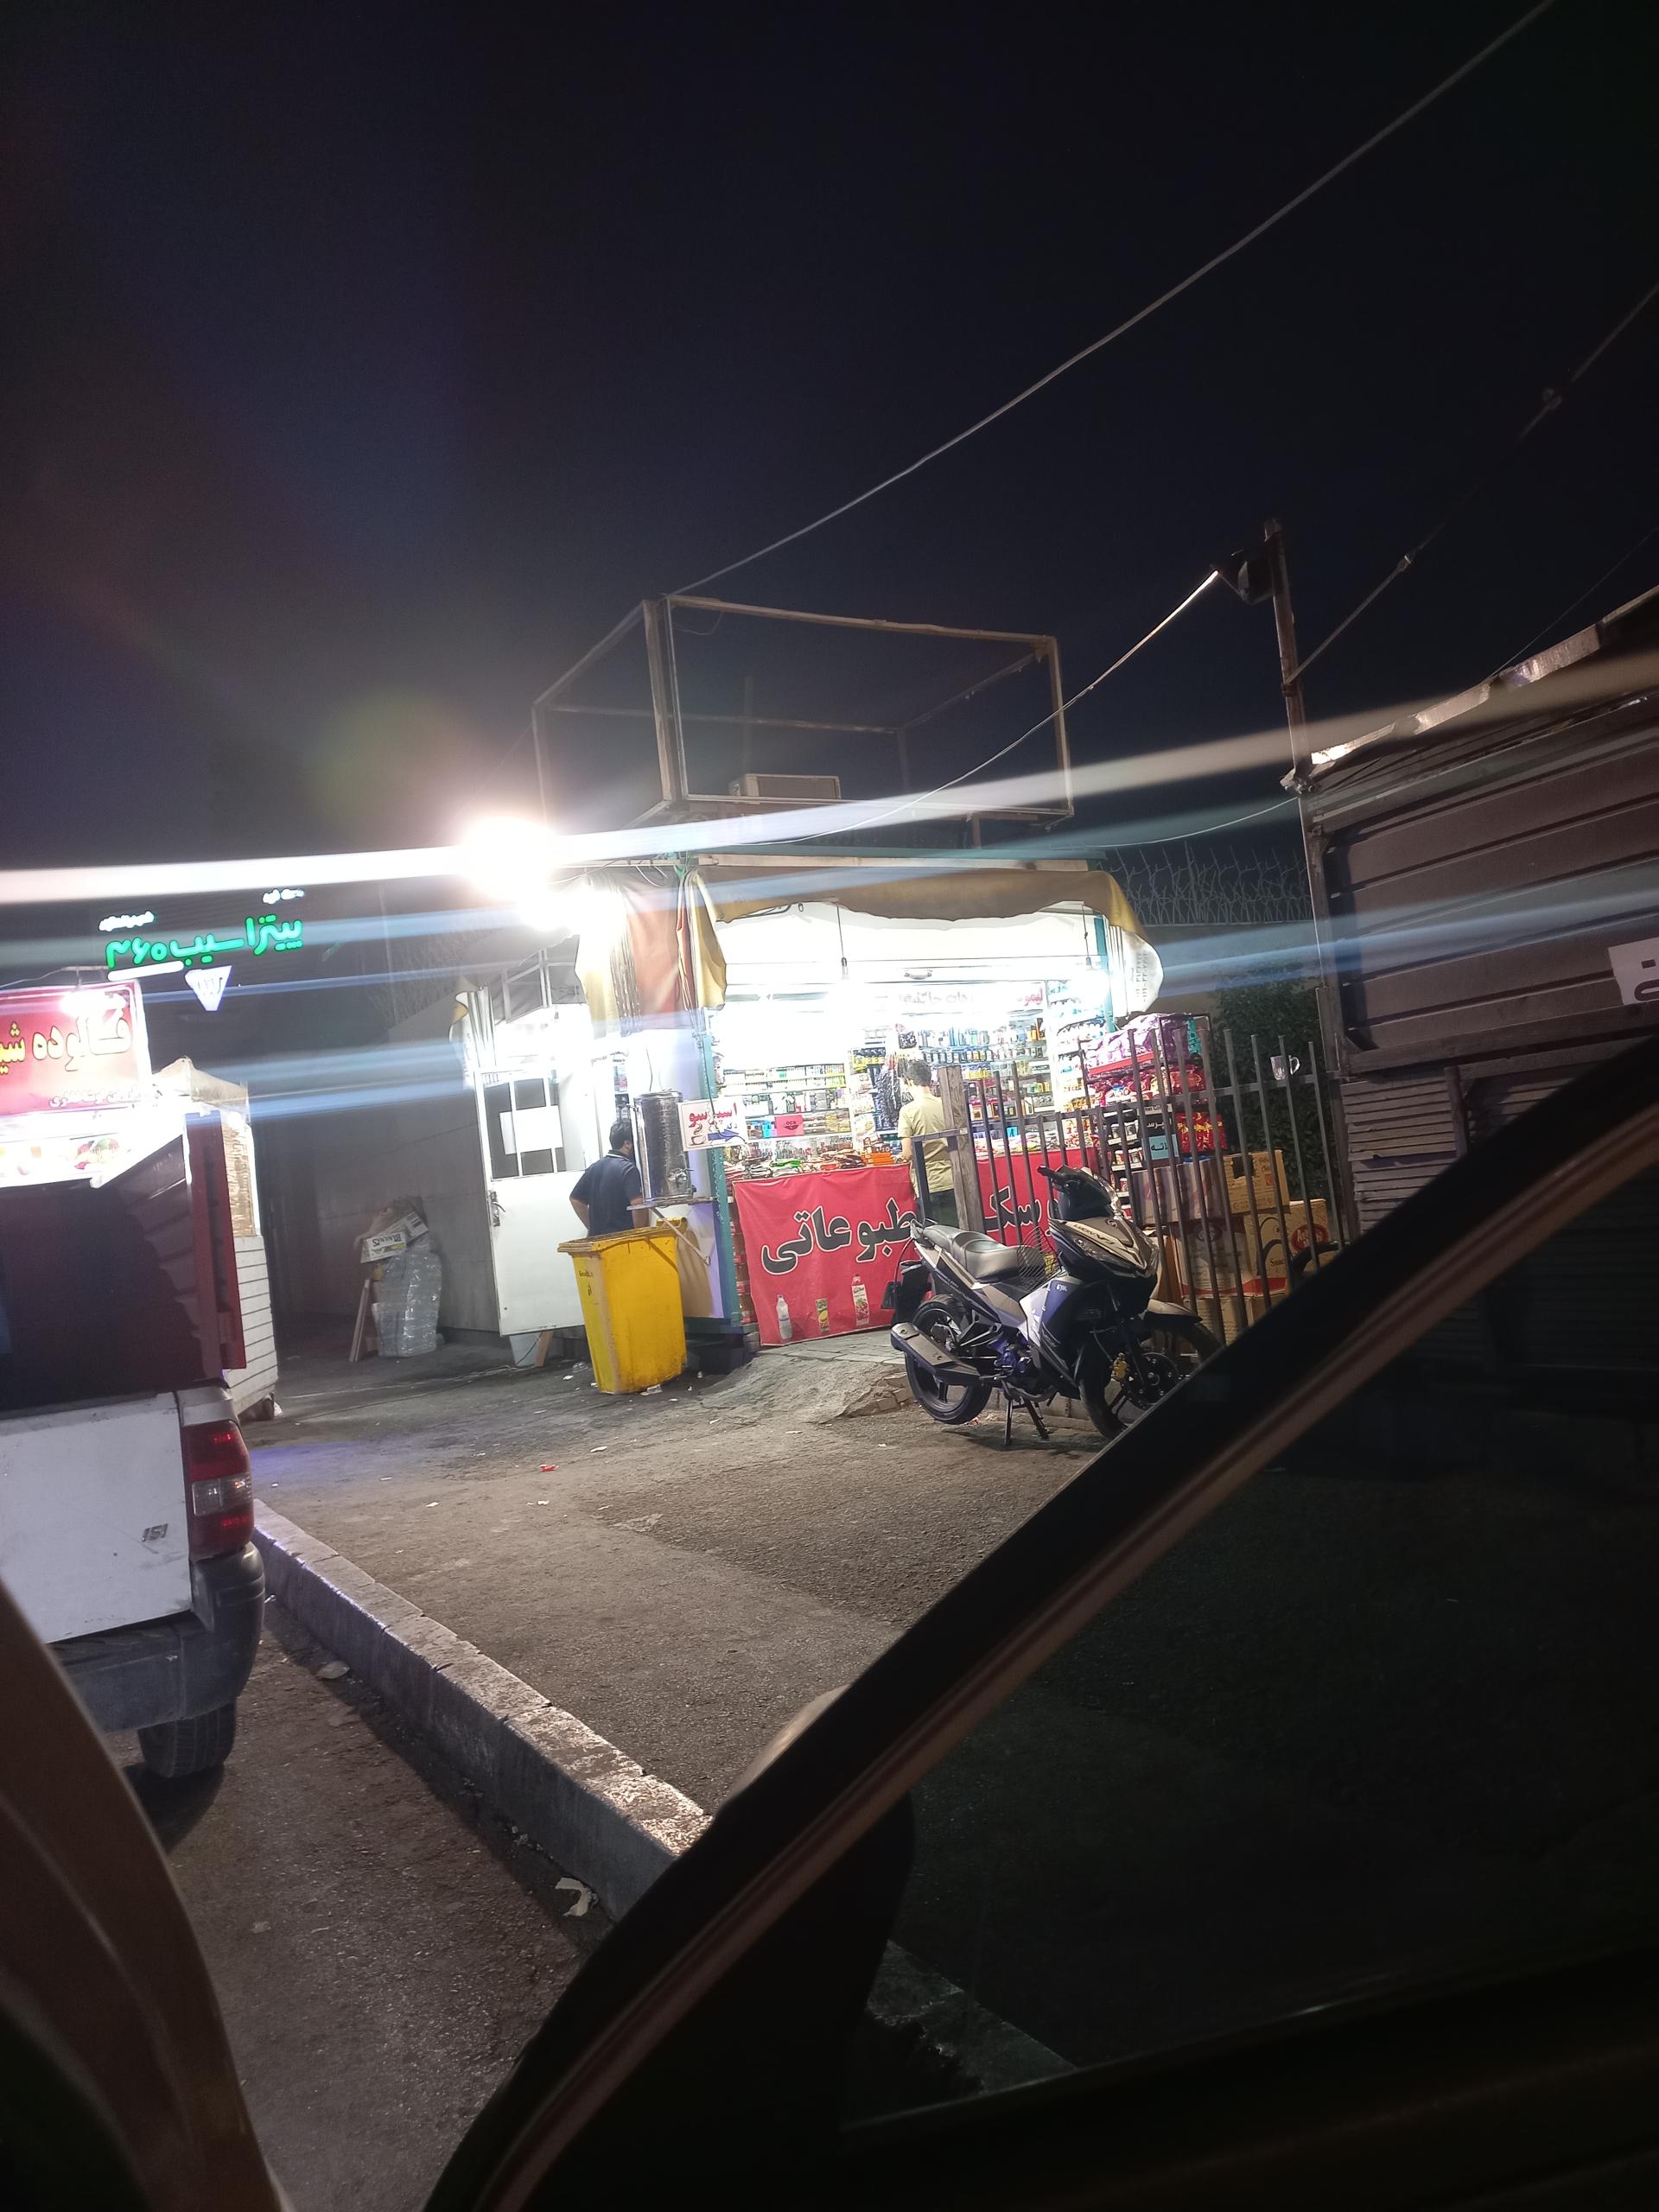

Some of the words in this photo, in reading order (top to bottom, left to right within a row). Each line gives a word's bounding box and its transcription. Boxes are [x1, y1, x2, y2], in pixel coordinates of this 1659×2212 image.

[169, 934, 245, 967] سیب
[245, 914, 303, 956] پیتزا
[761, 1197, 914, 1275] طبوعاتی
